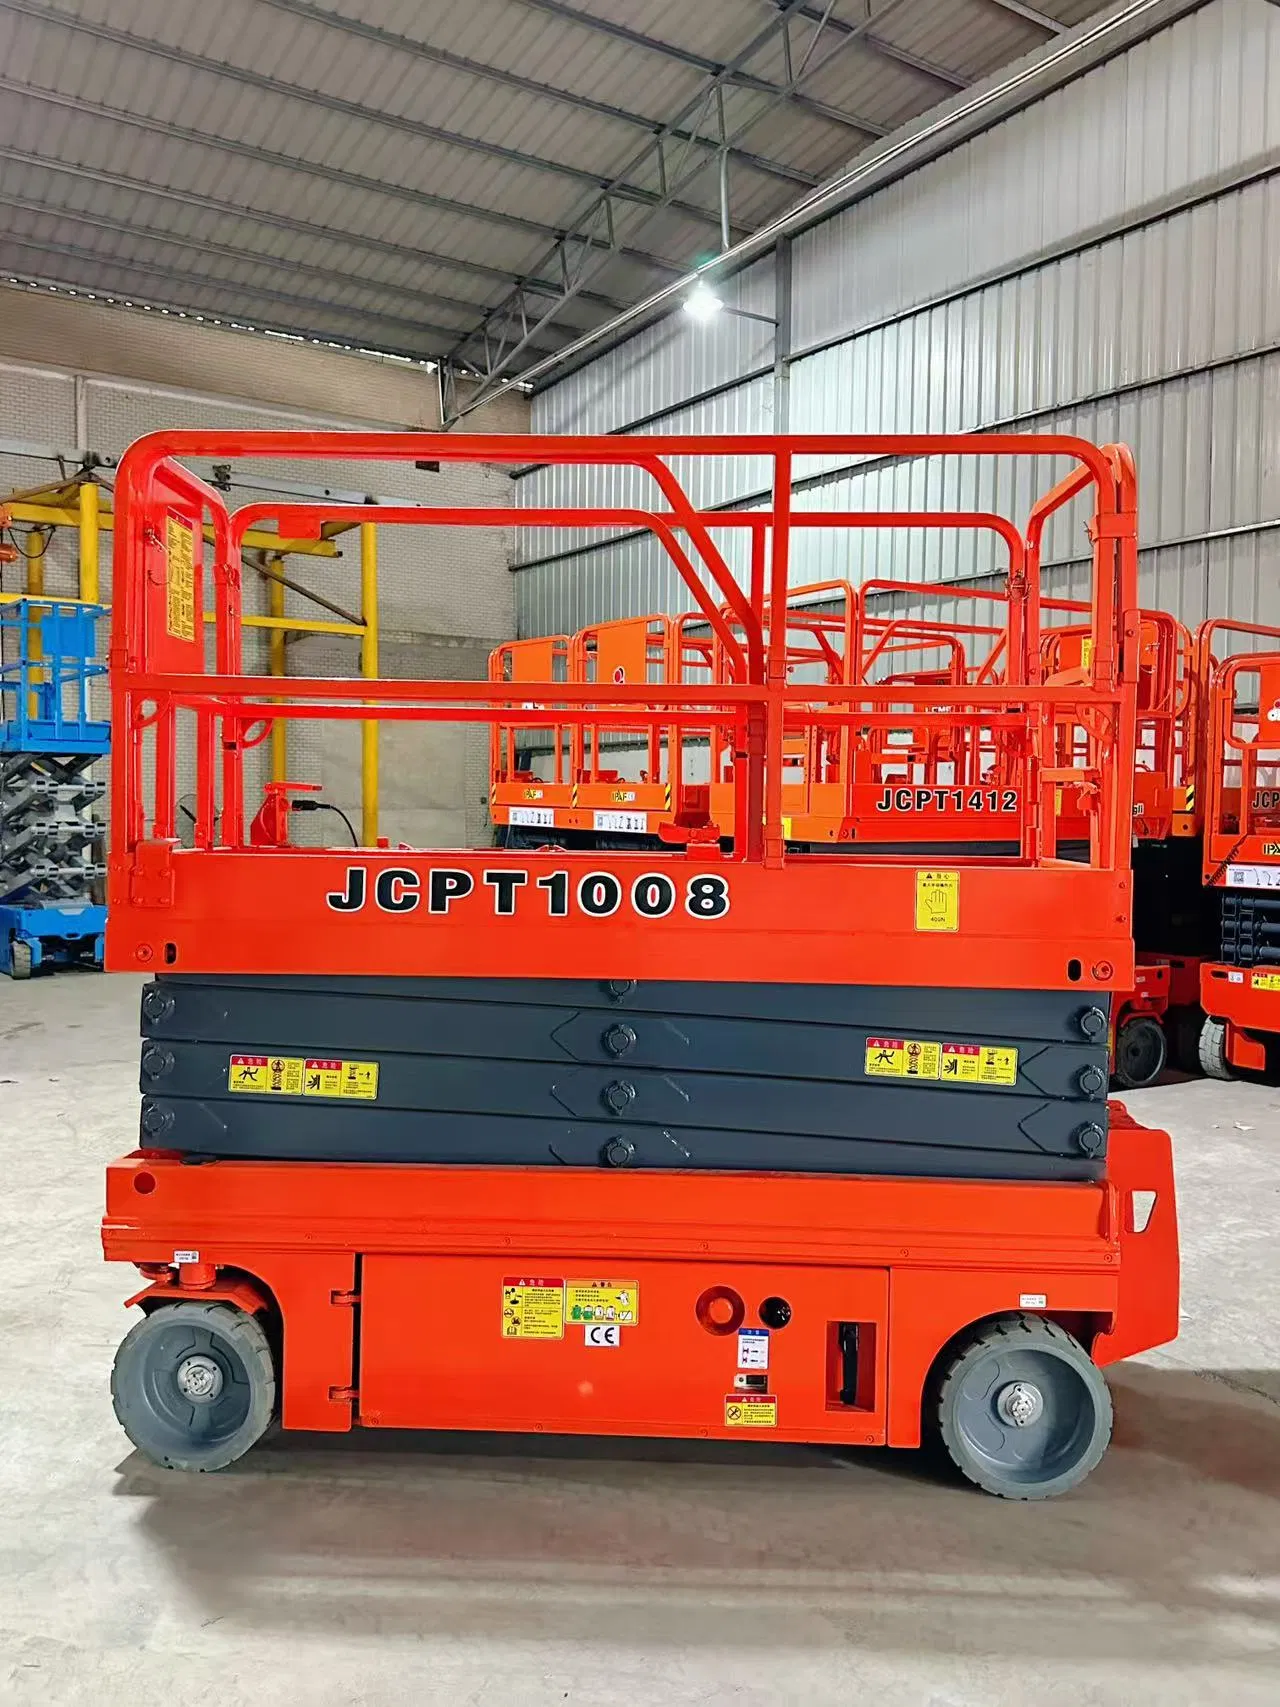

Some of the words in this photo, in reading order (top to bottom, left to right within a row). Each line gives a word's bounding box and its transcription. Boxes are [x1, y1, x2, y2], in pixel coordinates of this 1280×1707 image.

[876, 788, 1017, 812] JCPT1412
[1252, 790, 1280, 809] JCP
[326, 867, 730, 919] JCPT1008
[590, 1326, 615, 1344] CE
